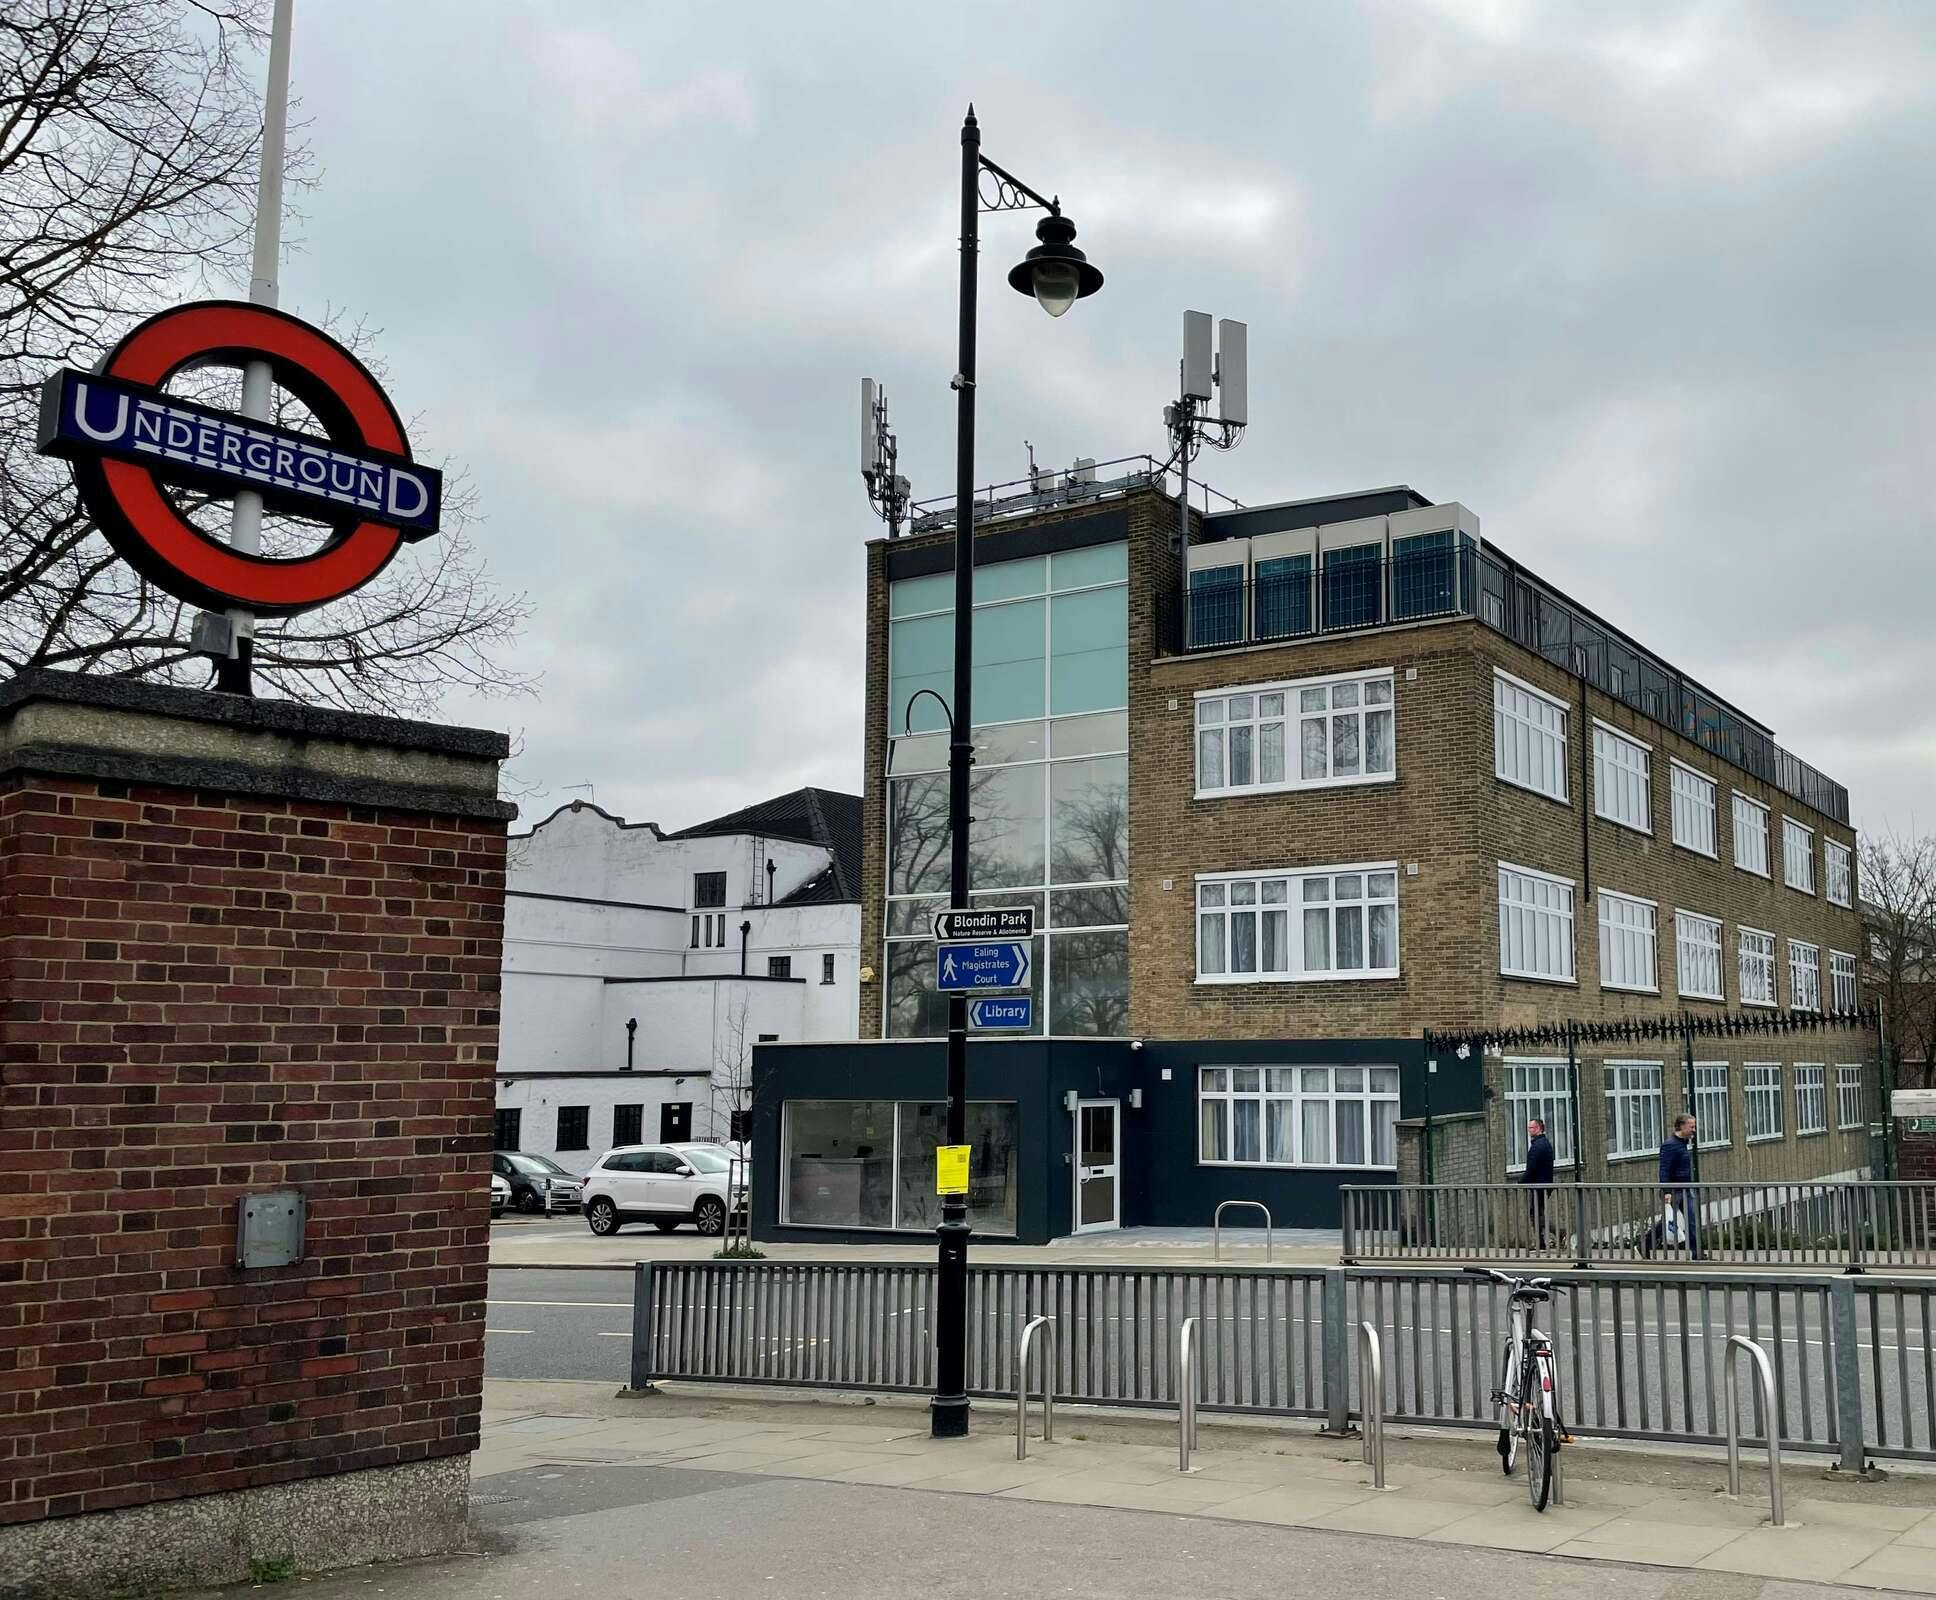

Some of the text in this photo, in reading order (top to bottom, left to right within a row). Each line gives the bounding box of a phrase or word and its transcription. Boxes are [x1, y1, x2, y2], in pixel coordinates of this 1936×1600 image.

[75, 384, 429, 517] UNDERGROUND
[954, 912, 1026, 928] Blondin Park
[974, 948, 998, 958] Ealing
[962, 961, 1010, 971] Magistrates
[974, 974, 997, 984] Court
[985, 1005, 1026, 1018] Library
